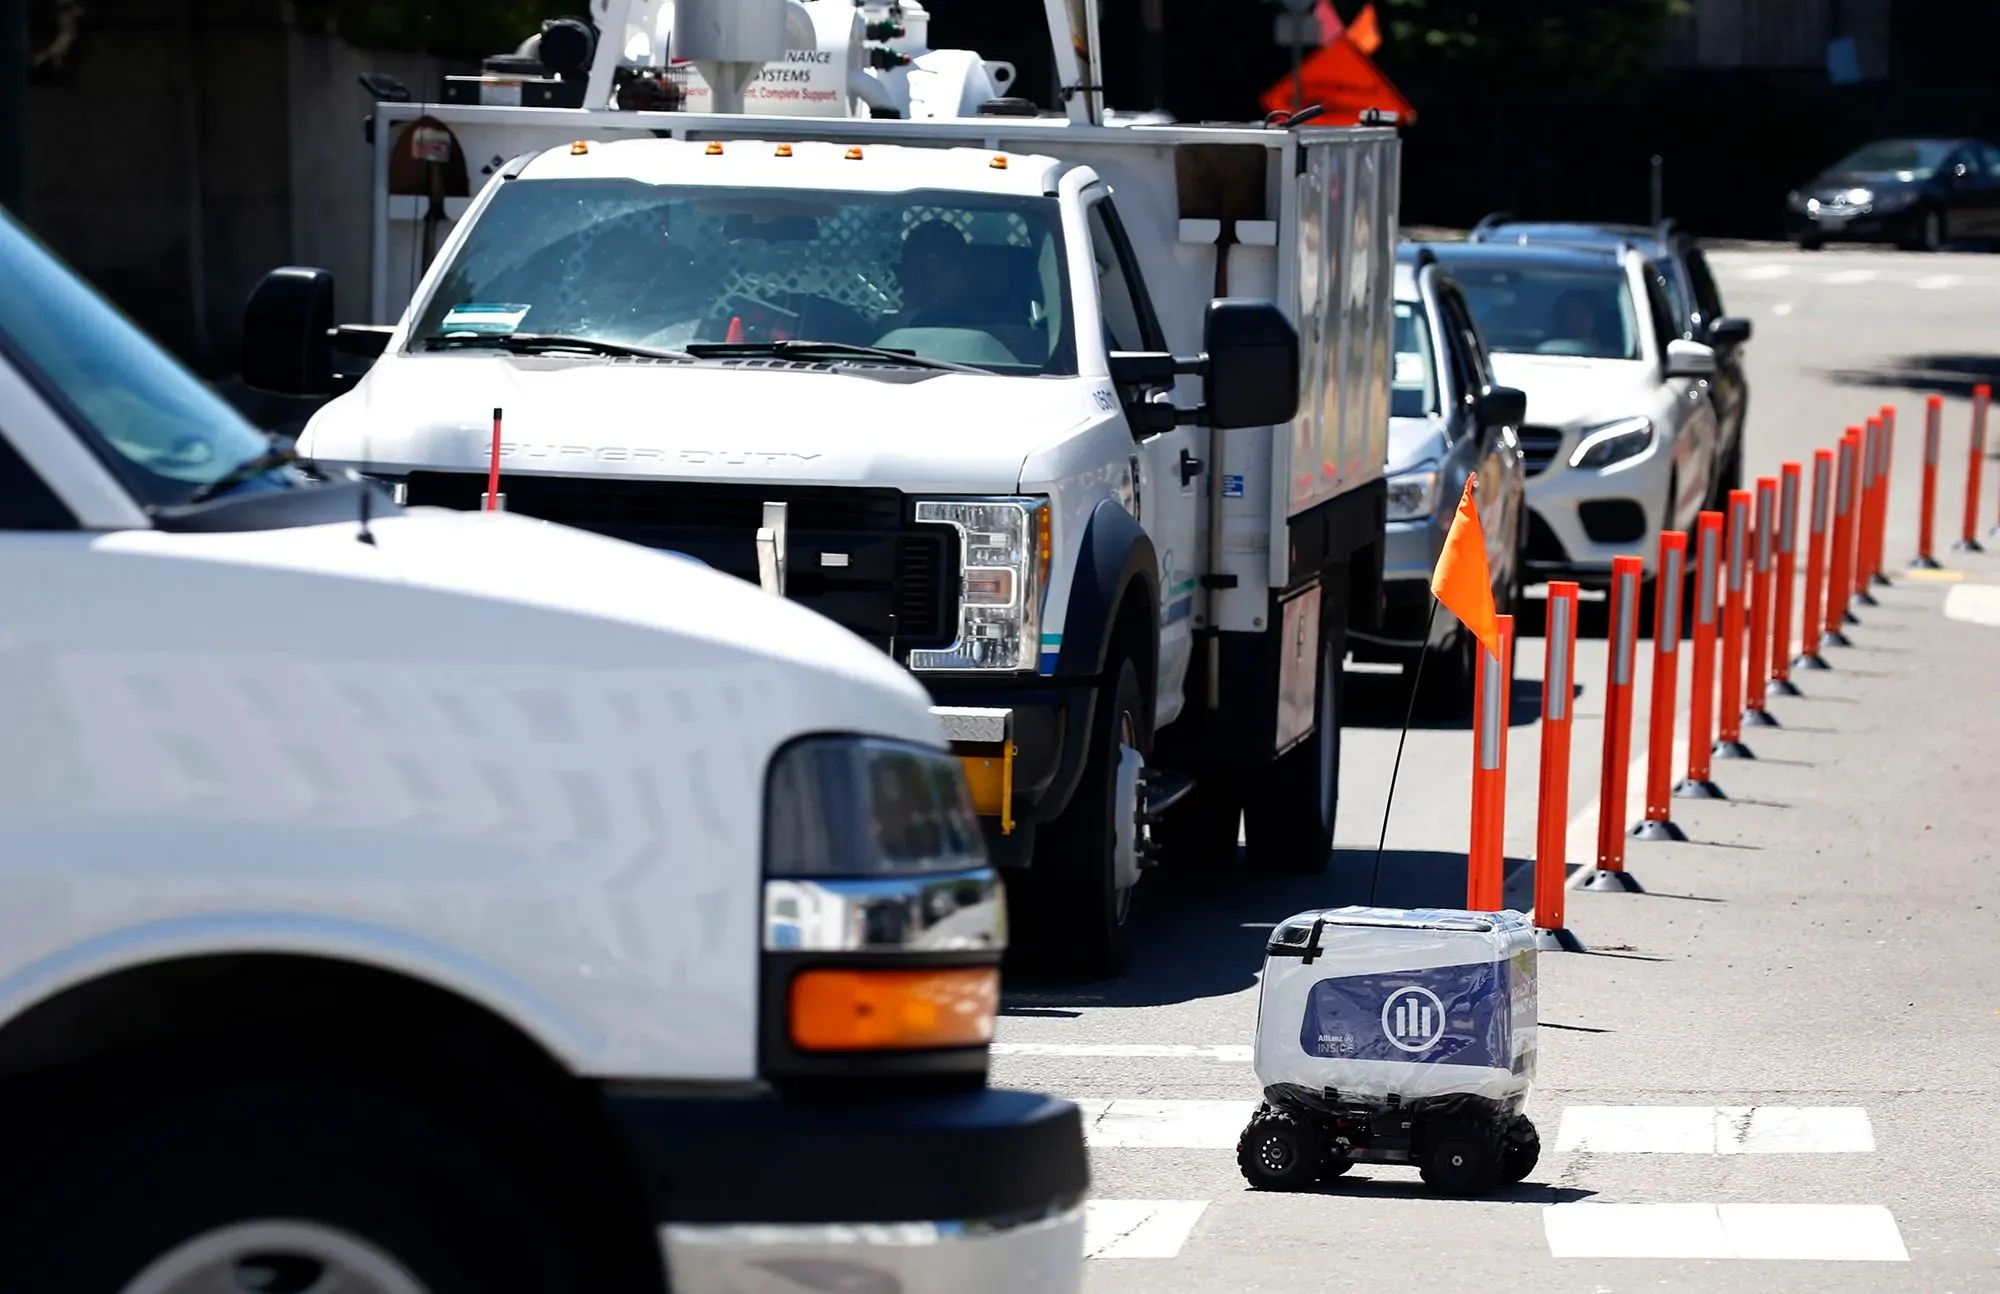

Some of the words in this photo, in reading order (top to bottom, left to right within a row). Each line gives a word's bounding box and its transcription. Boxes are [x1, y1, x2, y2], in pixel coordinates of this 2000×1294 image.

[760, 86, 800, 100] Complete
[484, 442, 666, 463] SUPER
[678, 449, 823, 467] DUTY
